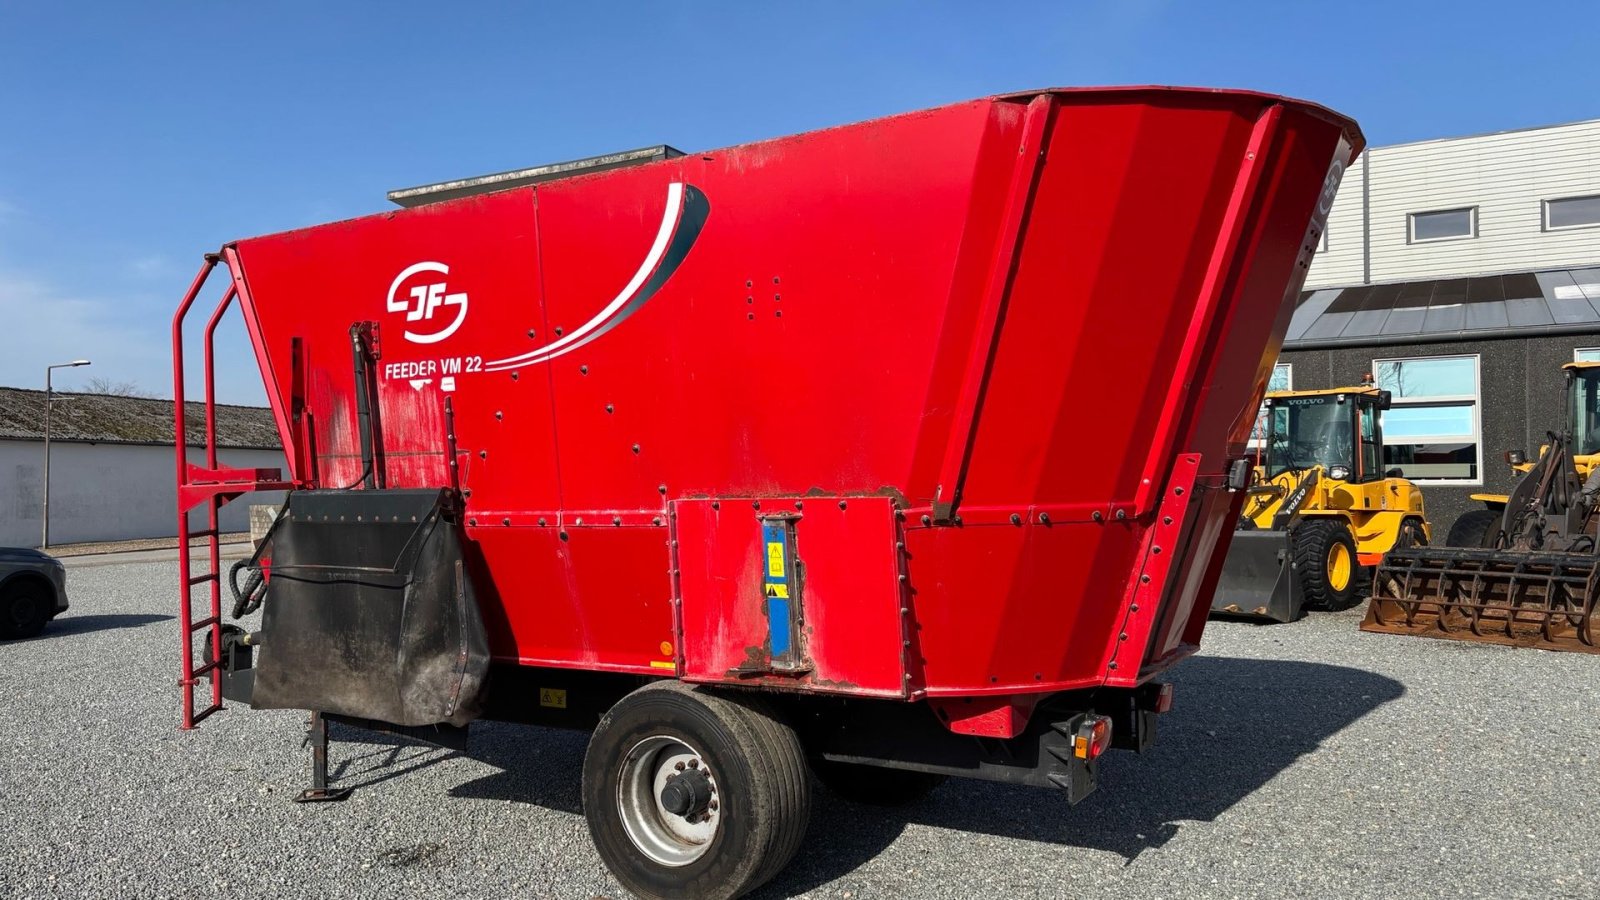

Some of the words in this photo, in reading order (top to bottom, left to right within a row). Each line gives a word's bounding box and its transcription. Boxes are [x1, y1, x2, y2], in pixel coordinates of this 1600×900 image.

[406, 282, 447, 322] JF
[385, 360, 436, 380] FEEDER
[440, 357, 461, 375] VM
[465, 355, 482, 373] 22
[1288, 398, 1325, 406] VOLVO
[1285, 488, 1306, 515] VOLVO
